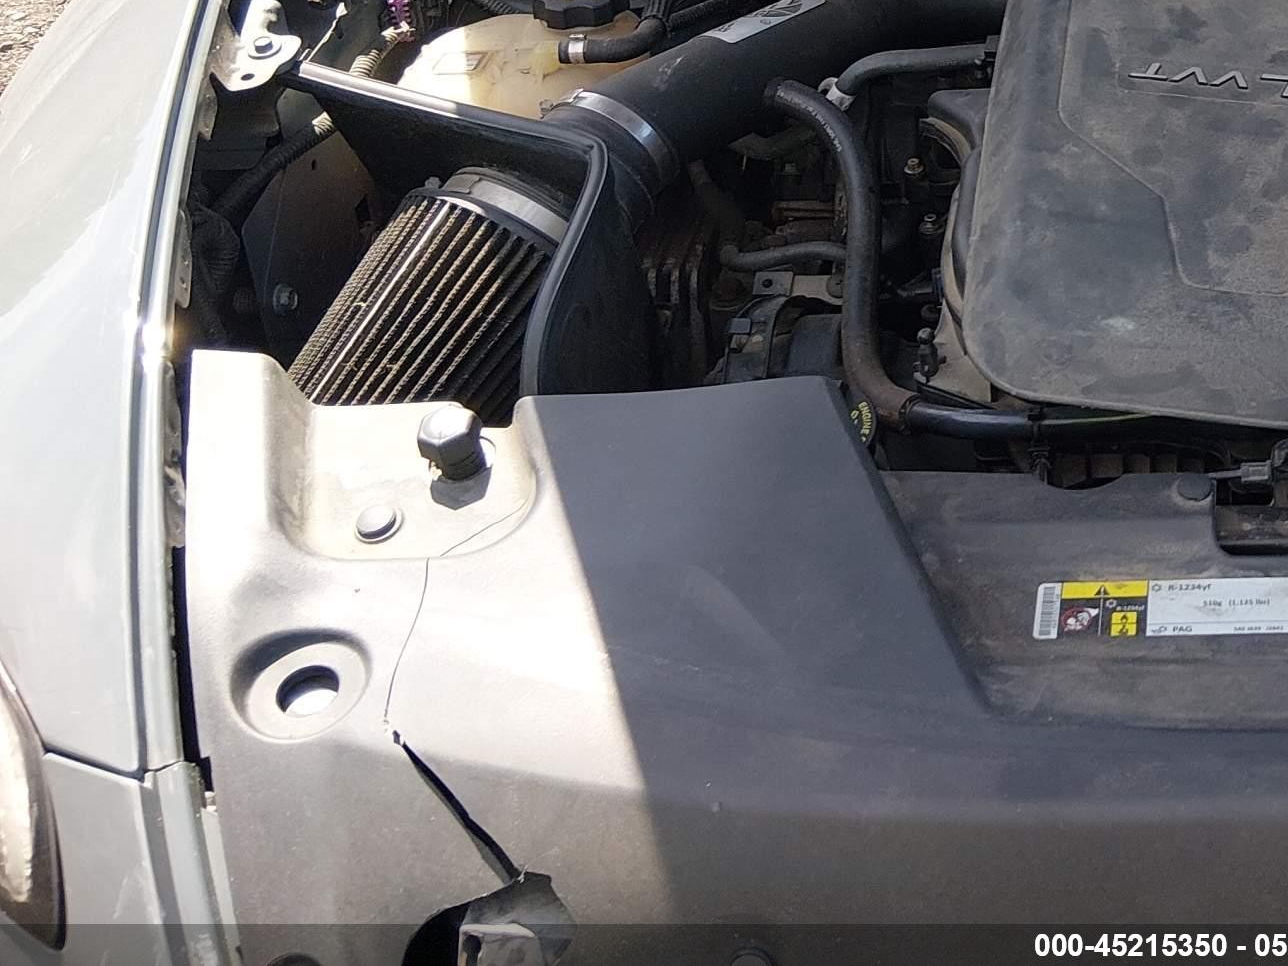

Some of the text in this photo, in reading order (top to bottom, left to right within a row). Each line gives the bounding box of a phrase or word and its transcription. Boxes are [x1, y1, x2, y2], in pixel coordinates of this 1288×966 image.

[1128, 62, 1249, 90] VVT
[858, 401, 872, 436] ENGINE
[1168, 583, 1212, 592] R-1234yf
